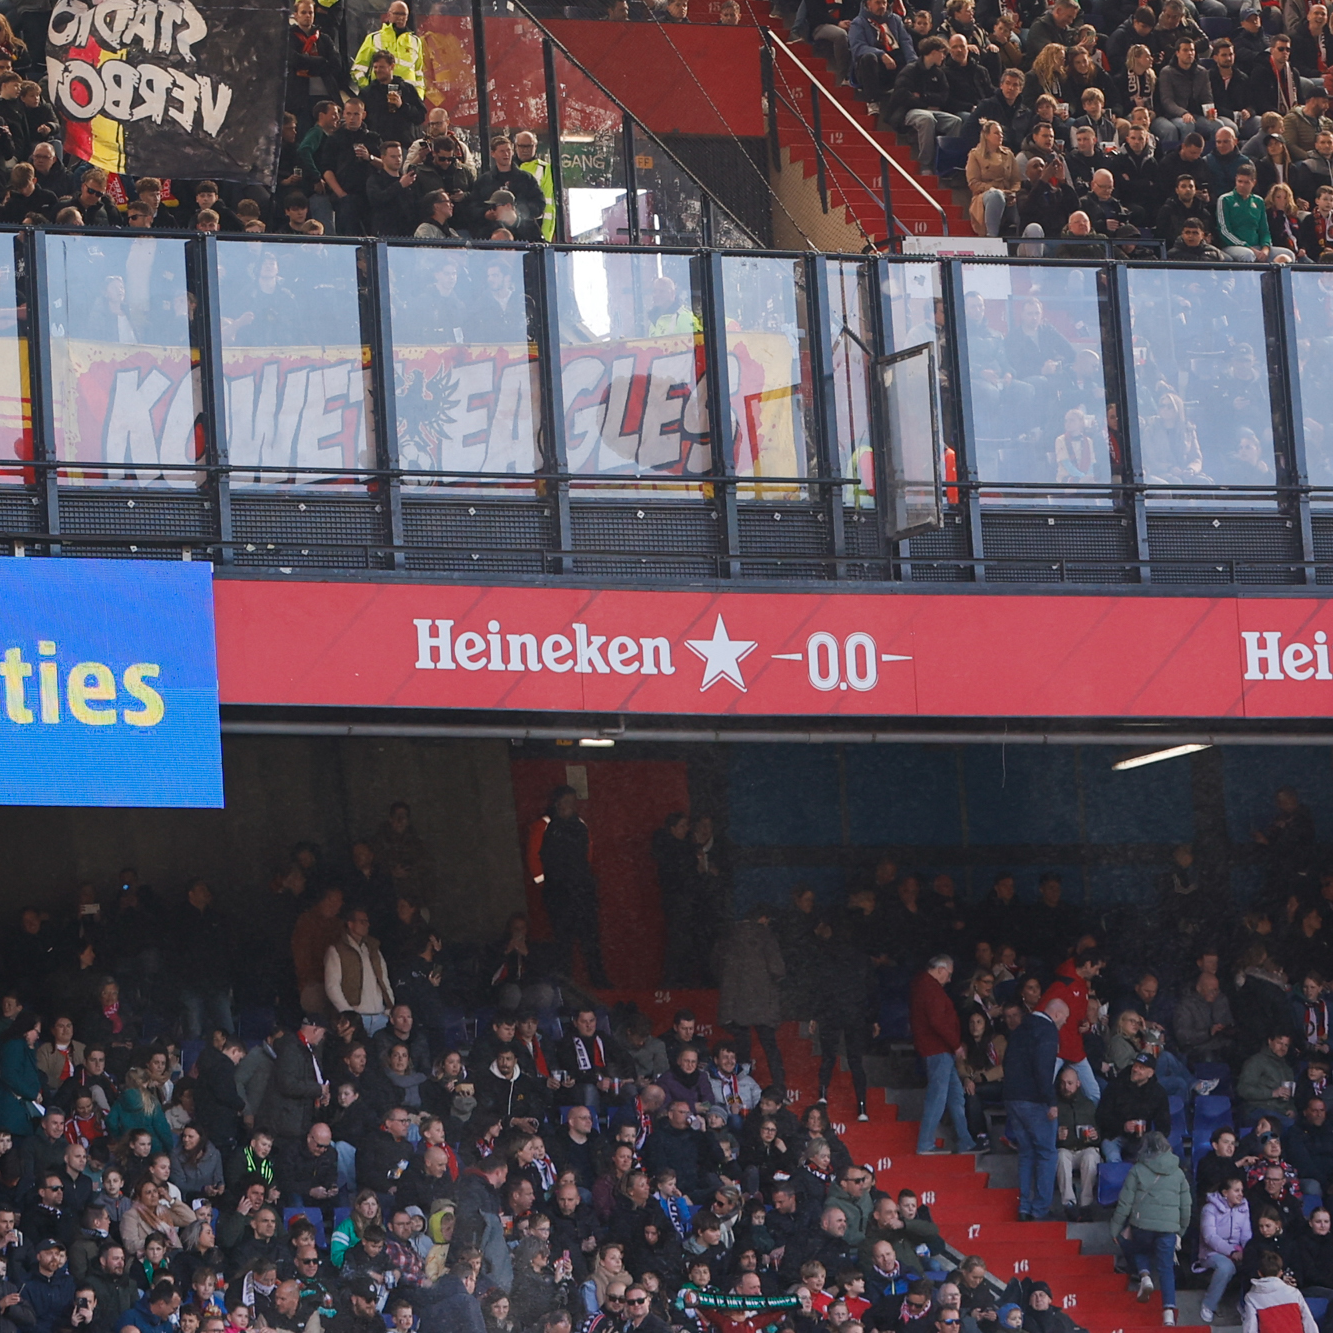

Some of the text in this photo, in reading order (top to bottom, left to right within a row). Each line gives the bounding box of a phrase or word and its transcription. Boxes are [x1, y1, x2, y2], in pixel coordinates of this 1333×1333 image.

[914, 222, 928, 234] 10
[438, 350, 742, 483] EAGLES
[413, 618, 676, 675] Heineken
[654, 991, 671, 1004] 24
[877, 1157, 892, 1172] 19
[921, 1191, 935, 1206] 18
[968, 1224, 981, 1239] 17
[1013, 1259, 1030, 1274] 16
[1062, 1293, 1077, 1309] 15
